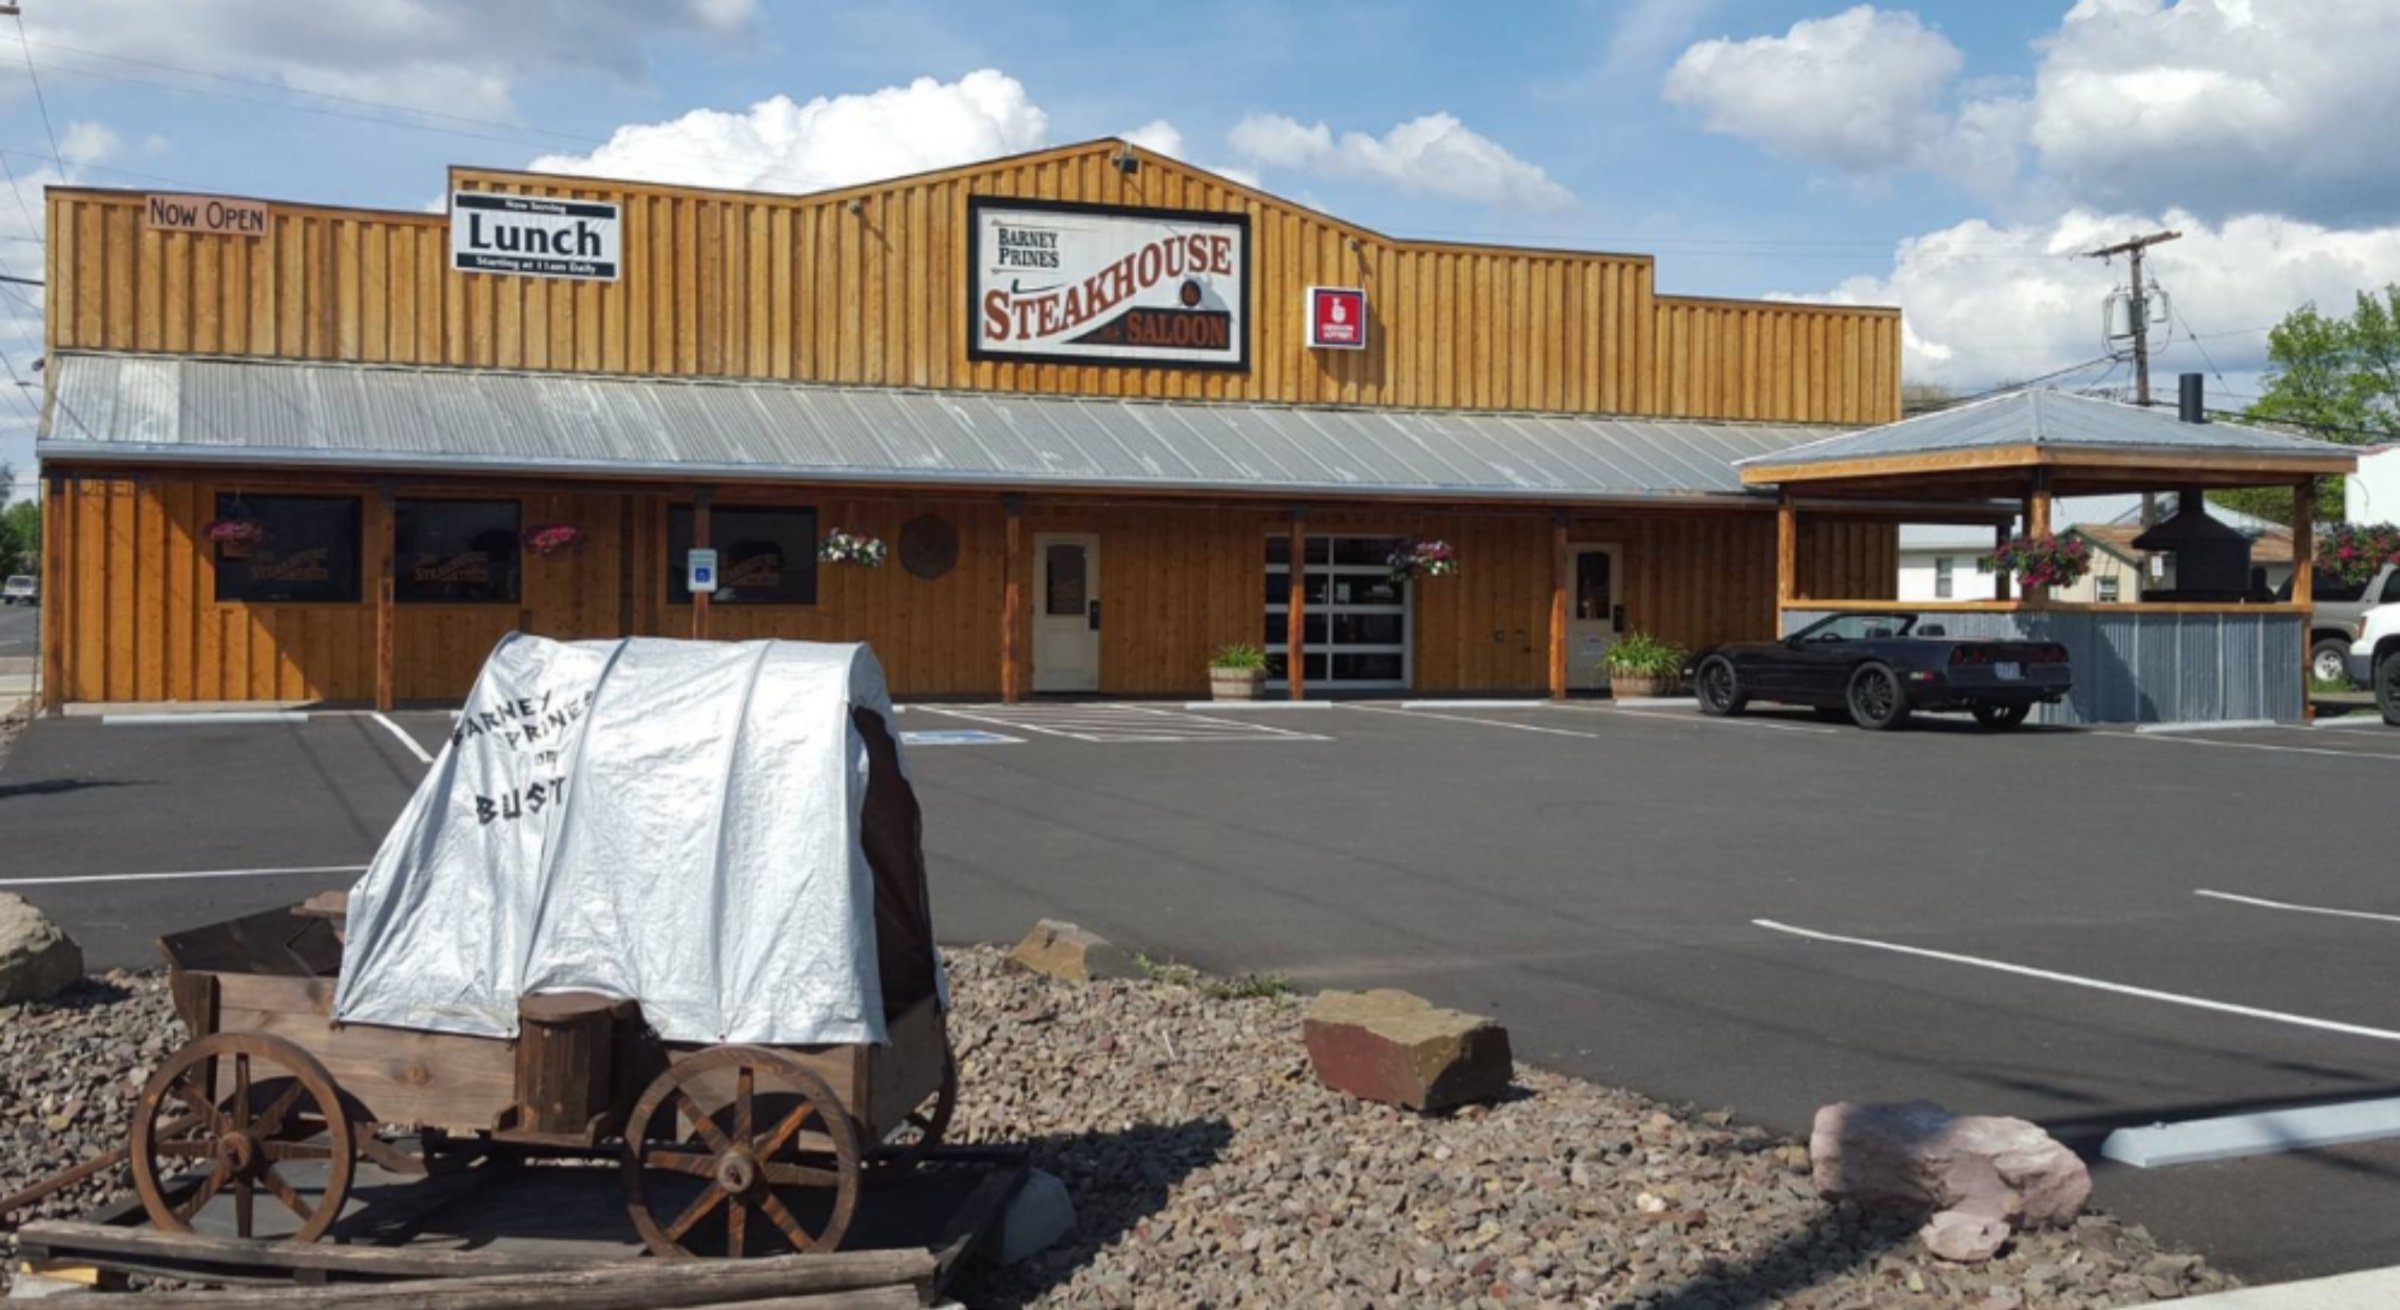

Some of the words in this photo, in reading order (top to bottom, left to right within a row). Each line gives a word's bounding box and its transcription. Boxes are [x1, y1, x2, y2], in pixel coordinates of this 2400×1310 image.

[151, 197, 198, 227] NOW
[206, 201, 263, 231] OPEN
[470, 213, 602, 257] Lunch
[999, 228, 1058, 249] BARNEY
[476, 256, 519, 270] Starting
[999, 248, 1060, 268] PRINES
[983, 233, 1232, 342] STEAKHOUSE
[1127, 312, 1227, 347] SALOON
[475, 776, 566, 826] BUST
